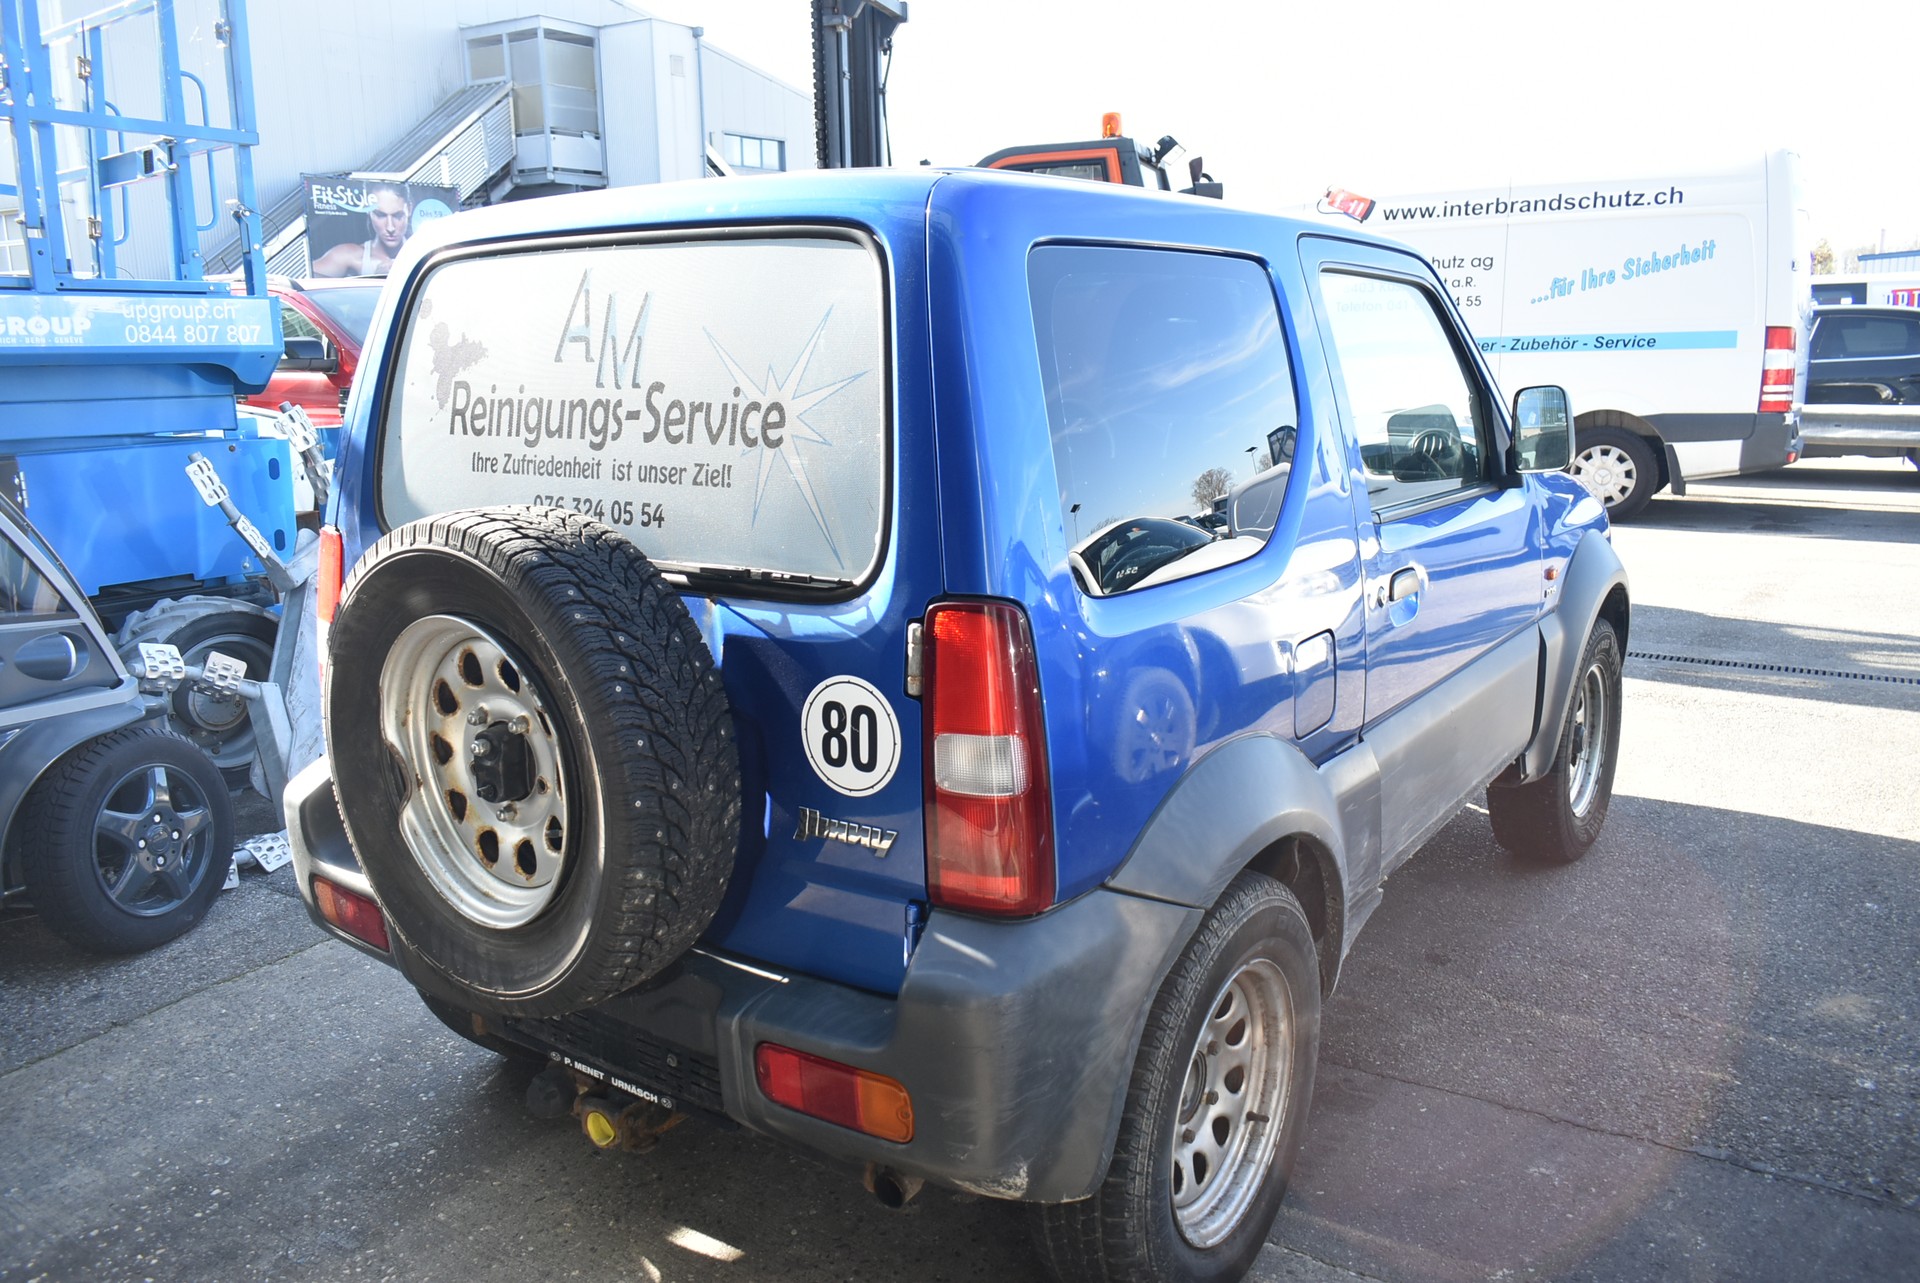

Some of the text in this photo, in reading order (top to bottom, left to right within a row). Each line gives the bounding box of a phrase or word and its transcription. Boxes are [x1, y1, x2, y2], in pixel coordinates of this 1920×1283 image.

[311, 184, 378, 211] Fit-Style
[1383, 187, 1684, 220] www.interbrandschutz.ch
[1471, 256, 1494, 271] ag
[1581, 268, 1616, 292] Ihre
[1622, 239, 1716, 280] Sicherheit
[122, 301, 237, 323] upgroup.ch
[1466, 295, 1482, 307] 55
[125, 325, 261, 343] 0844 807 807
[1510, 337, 1579, 351] Zubehör
[1594, 335, 1657, 349] Service
[449, 379, 787, 451] Reinigungs-Service
[471, 451, 733, 489] Ihre Zufriedenheit ist unser Ziel!
[572, 497, 605, 522] 324
[611, 500, 634, 526] 05
[641, 502, 665, 529] 54
[821, 700, 878, 773] 80
[574, 1061, 605, 1080] MENET
[611, 1076, 658, 1103] URNÄSCH
